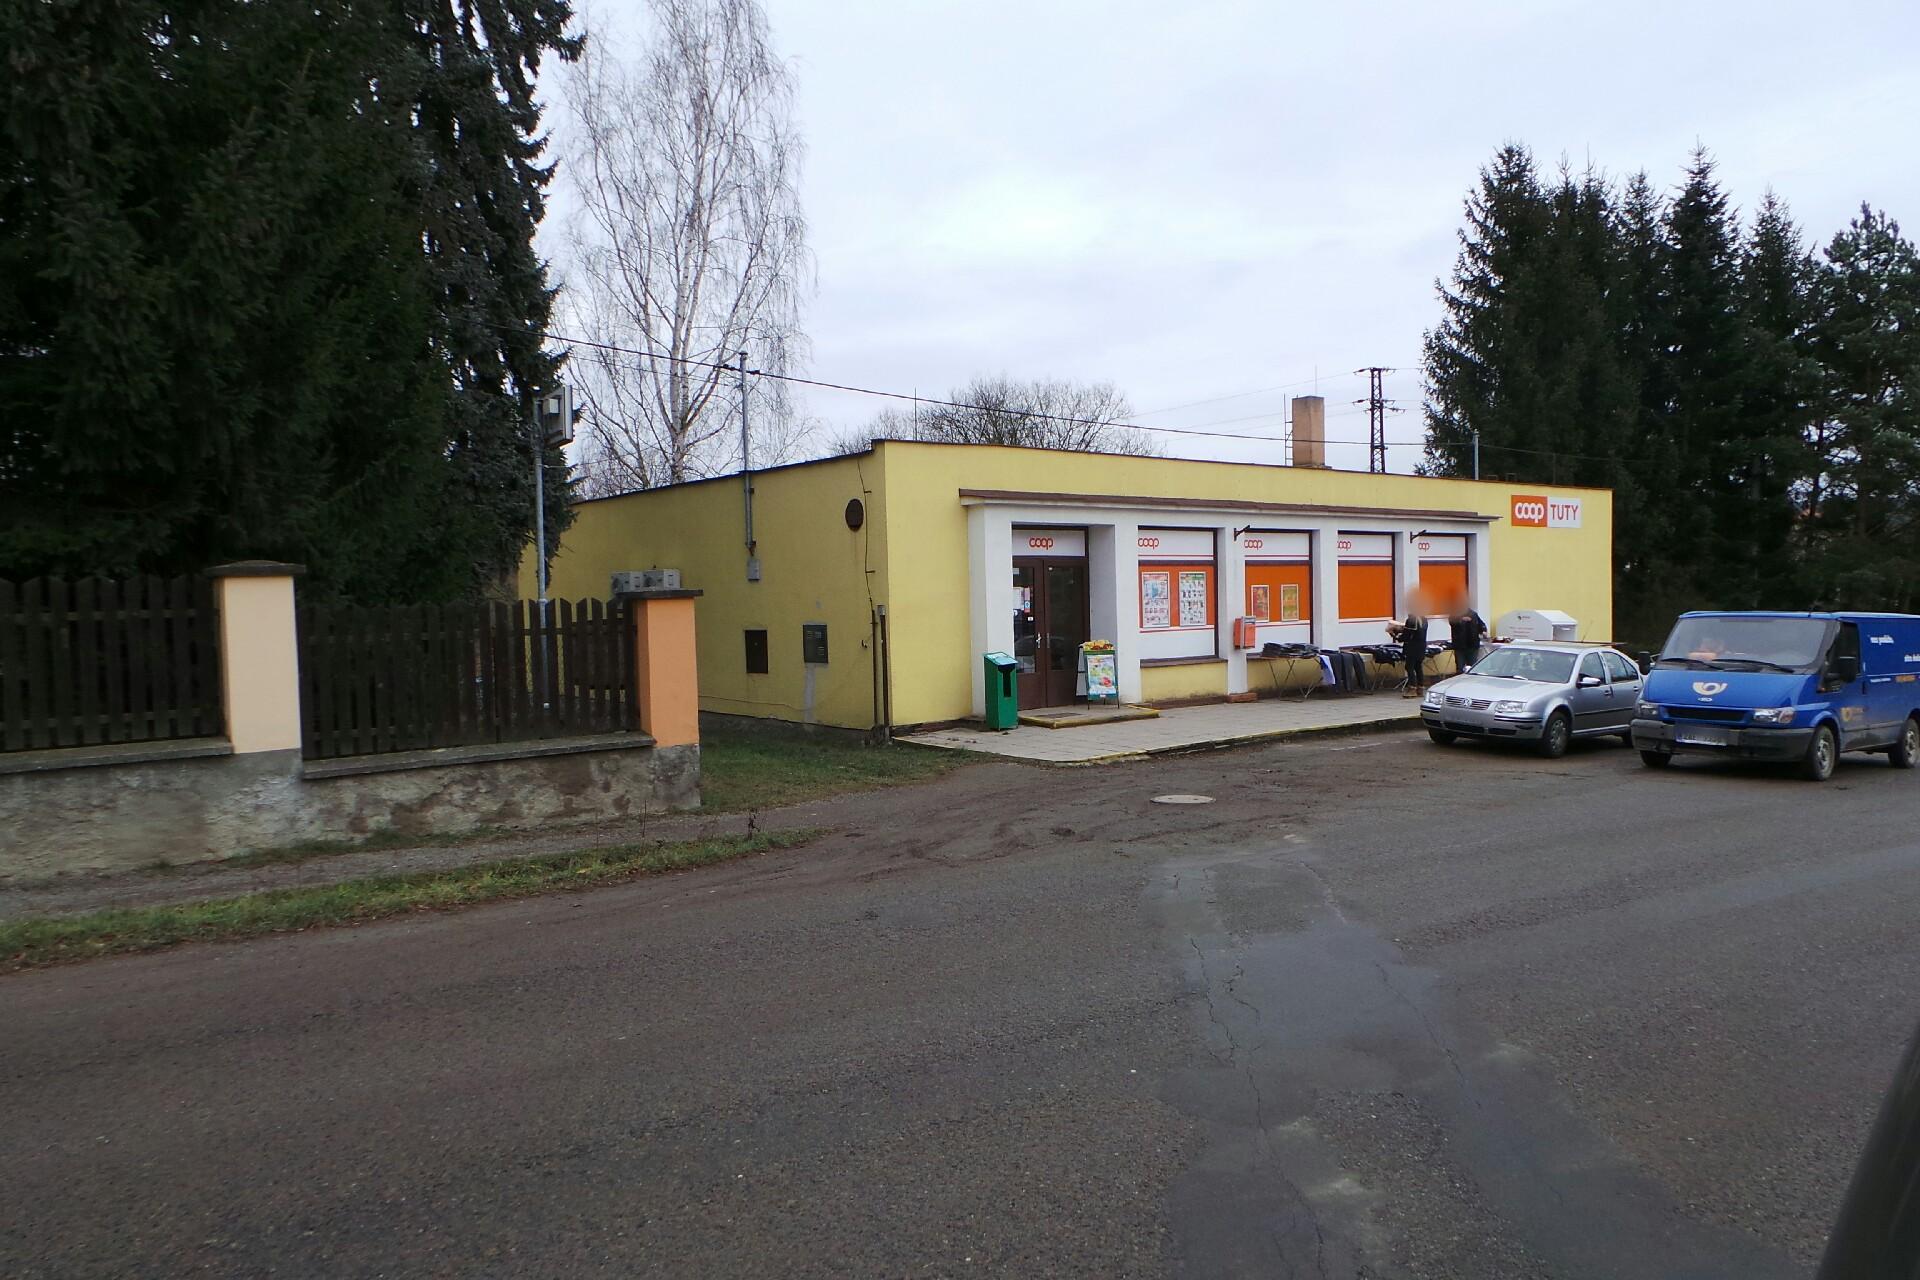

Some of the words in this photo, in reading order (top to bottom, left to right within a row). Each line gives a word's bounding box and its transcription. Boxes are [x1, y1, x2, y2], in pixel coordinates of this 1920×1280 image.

[1515, 502, 1544, 524] coop
[1550, 504, 1579, 520] TUTY
[1029, 537, 1053, 550] coop
[1137, 537, 1159, 550] coop
[1418, 542, 1430, 551] oop
